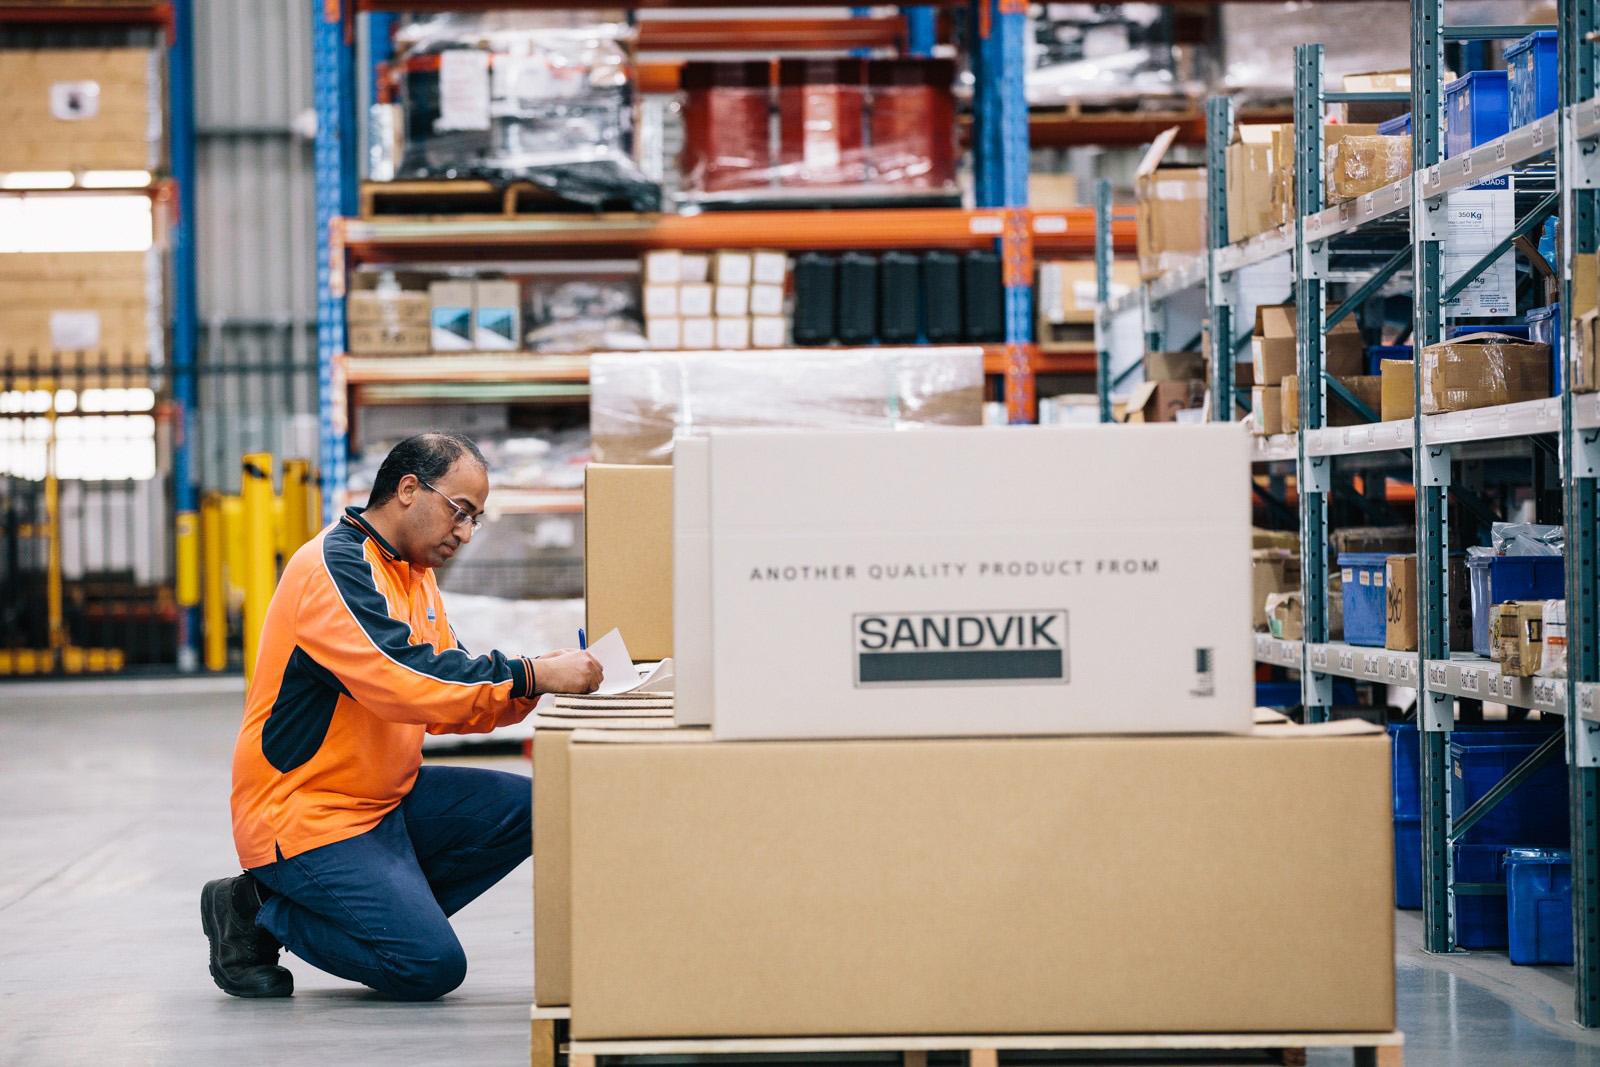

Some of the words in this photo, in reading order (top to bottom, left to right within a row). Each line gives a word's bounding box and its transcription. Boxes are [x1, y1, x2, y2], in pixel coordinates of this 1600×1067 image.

[751, 565, 856, 581] ANOTHER
[868, 563, 966, 580] QUALITY
[979, 560, 1084, 577] PRODUCT
[1096, 558, 1160, 575] FROM
[859, 615, 1059, 650] SANDVIK
